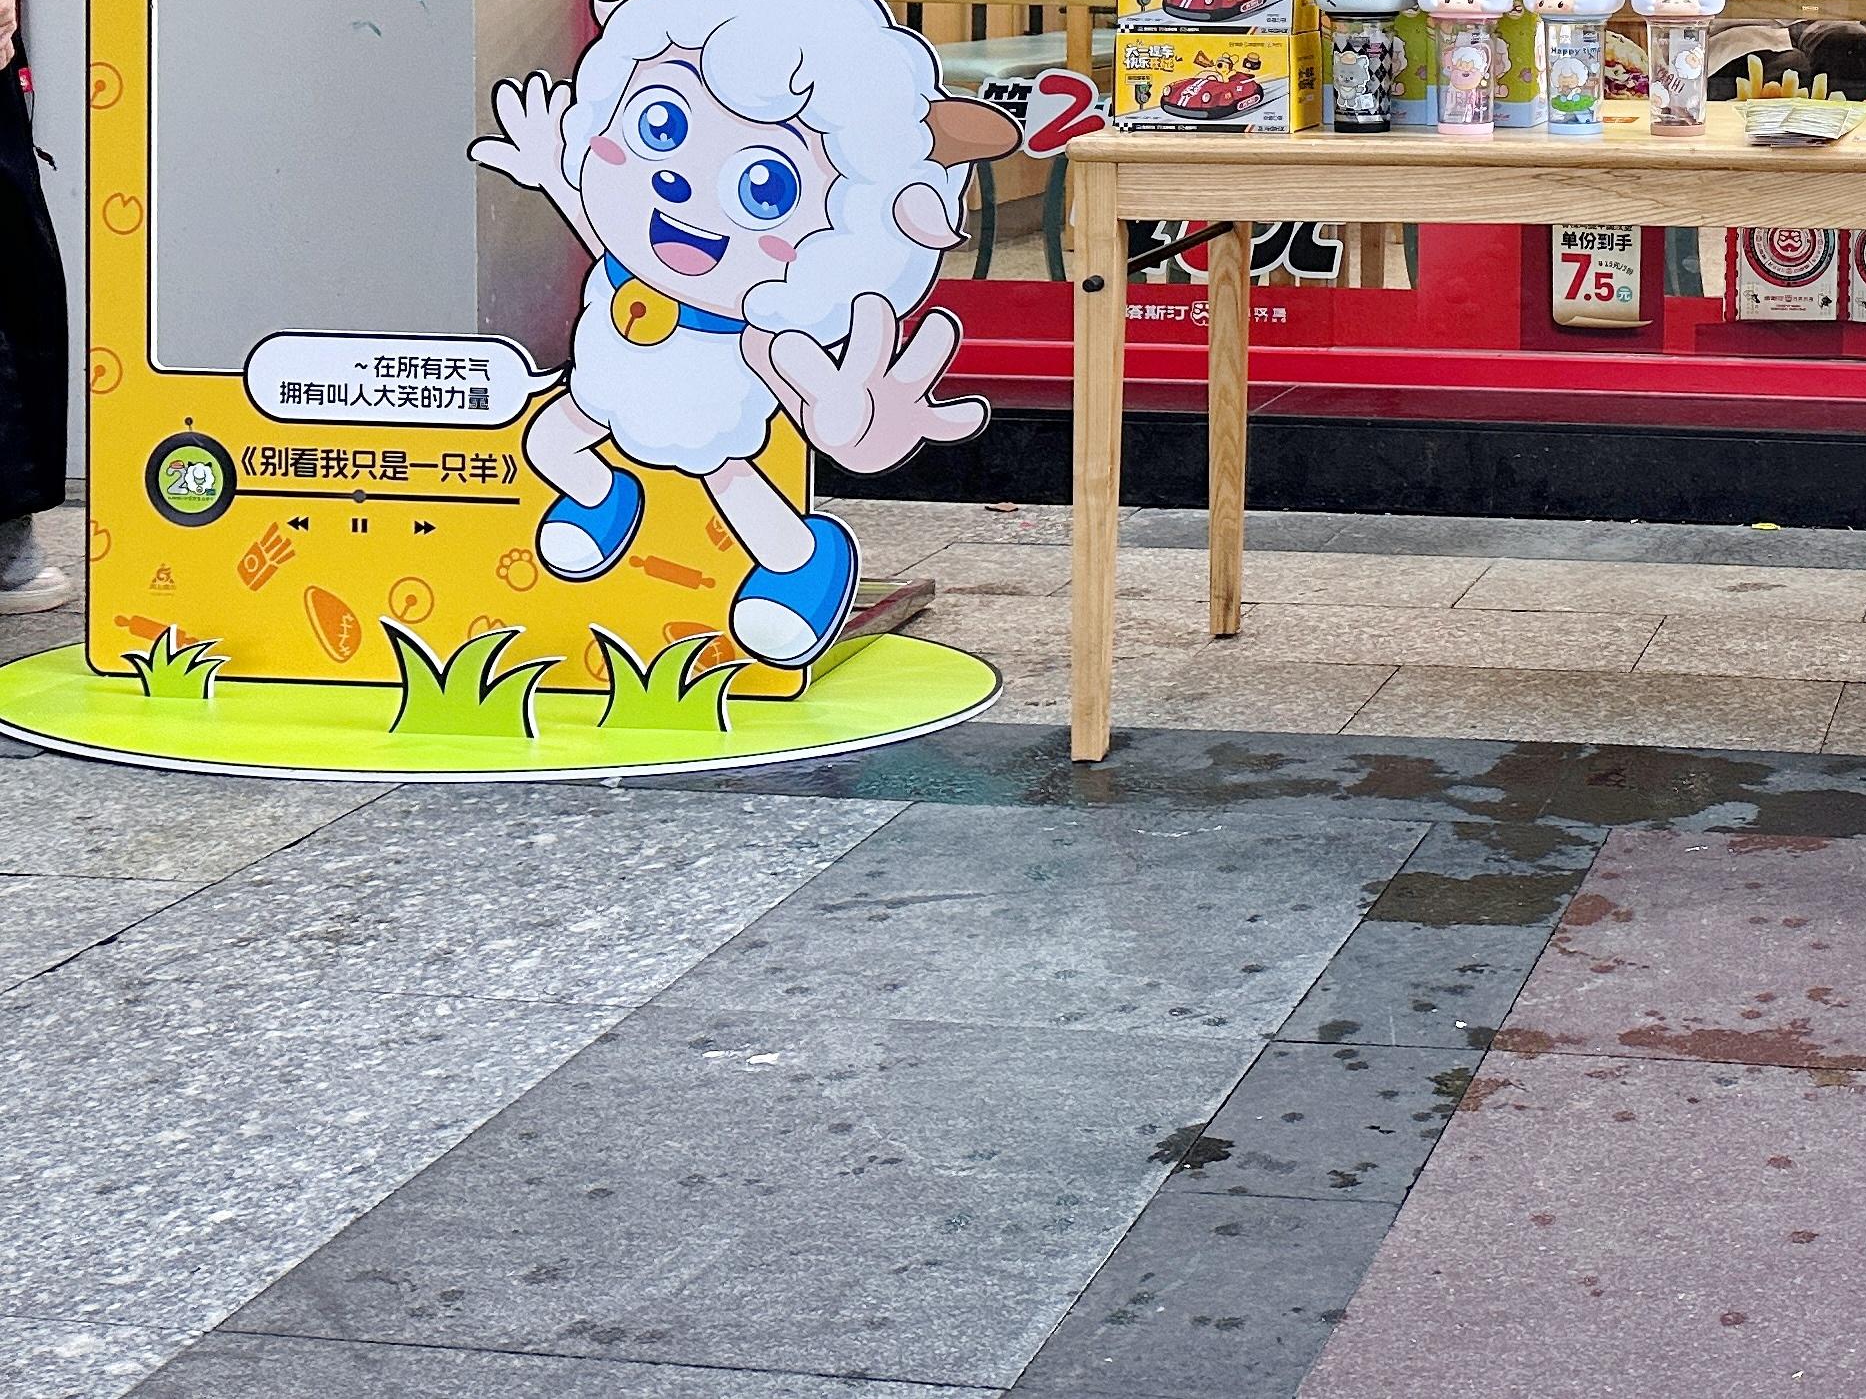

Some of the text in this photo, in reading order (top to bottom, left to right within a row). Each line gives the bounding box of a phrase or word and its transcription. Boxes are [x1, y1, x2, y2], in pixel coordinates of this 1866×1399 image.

[1560, 231, 1633, 252] 单份到手
[1560, 253, 1616, 301] 7.5
[279, 381, 491, 412] 拥有叫人大笑的力量
[239, 446, 518, 486] 《别看我只是一只羊》
